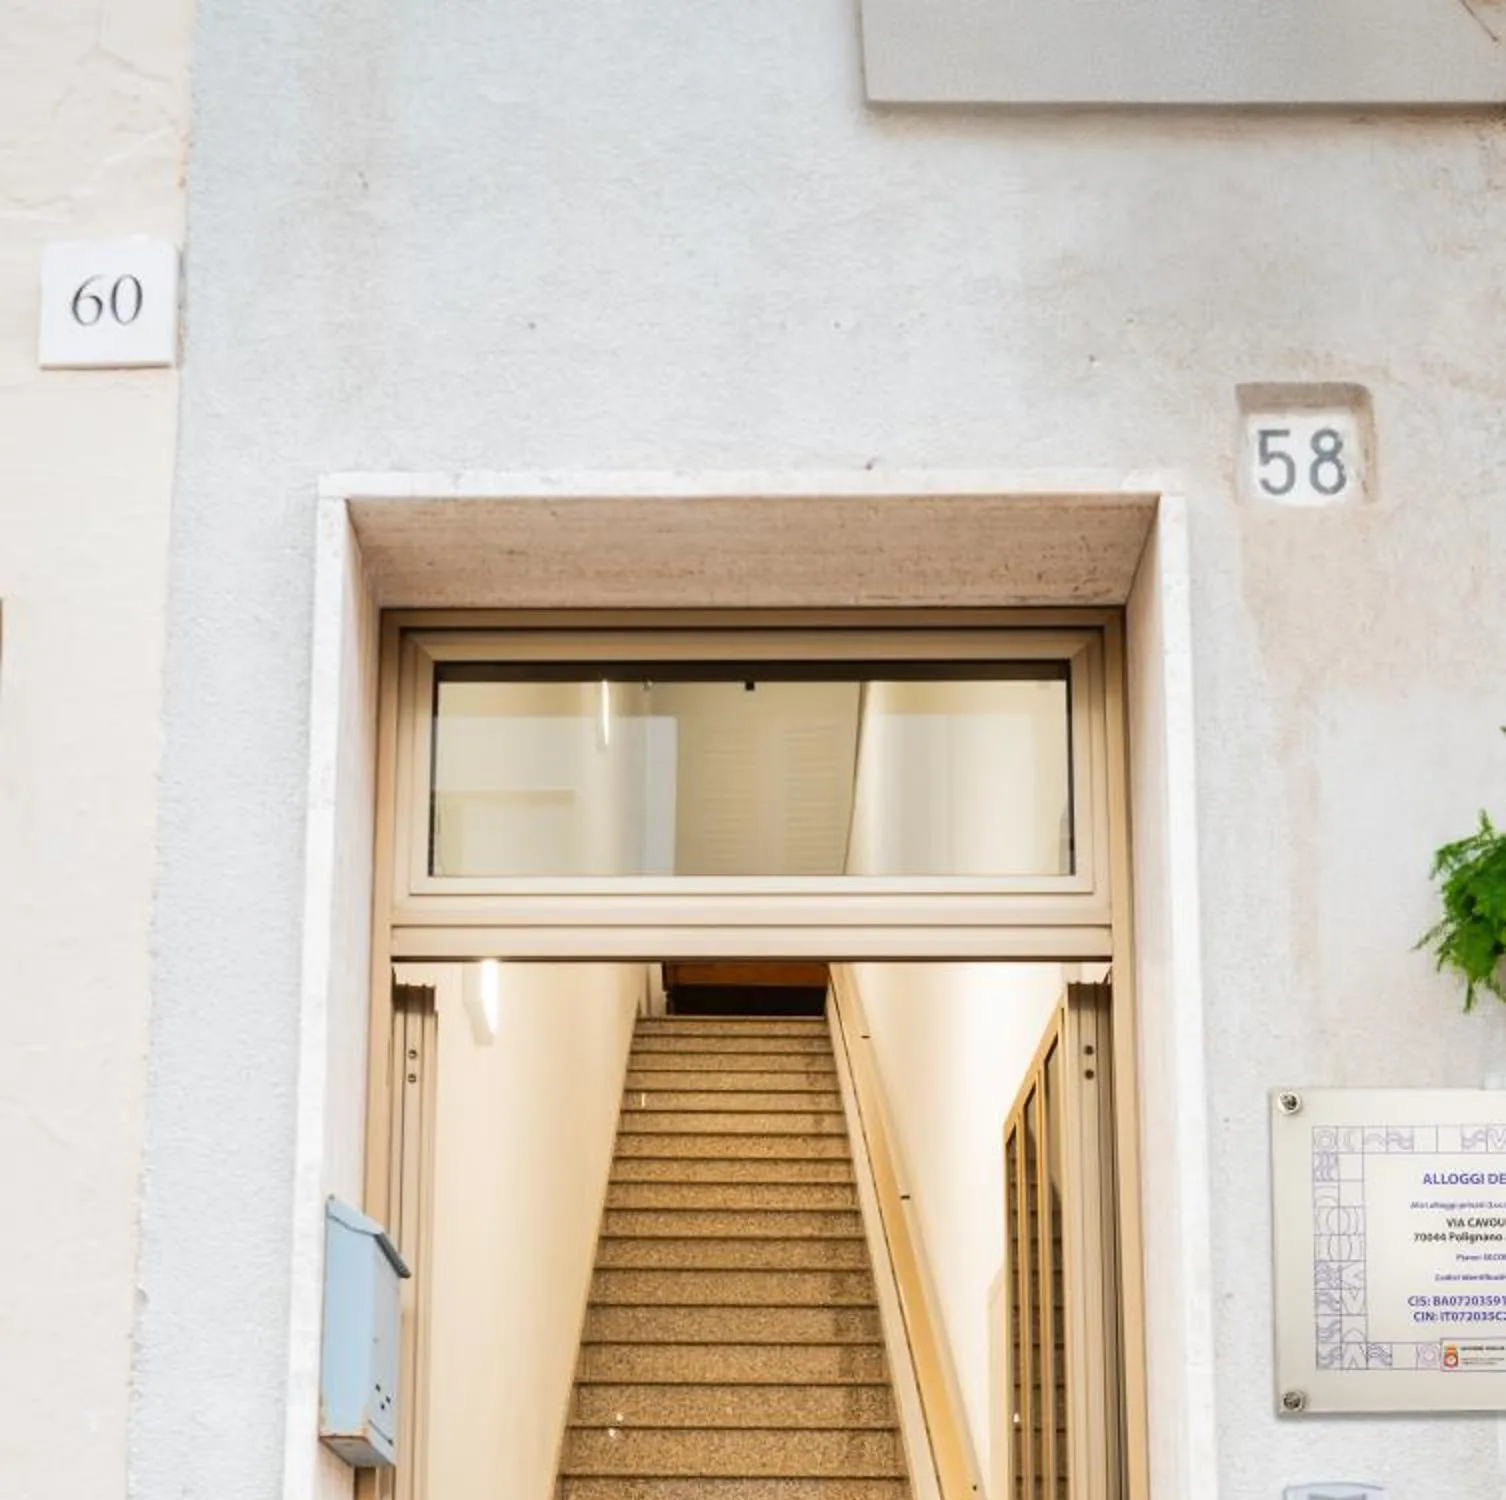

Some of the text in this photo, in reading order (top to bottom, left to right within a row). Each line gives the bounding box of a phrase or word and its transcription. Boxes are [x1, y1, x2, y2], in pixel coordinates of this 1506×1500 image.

[71, 273, 143, 326] 60
[1258, 428, 1346, 495] 58
[1423, 1173, 1485, 1185] ALLOGGI
[1446, 1218, 1465, 1228] VIA
[1449, 1232, 1503, 1244] Polignano
[1408, 1296, 1431, 1307] CIS:
[1413, 1312, 1437, 1322] CIN:
